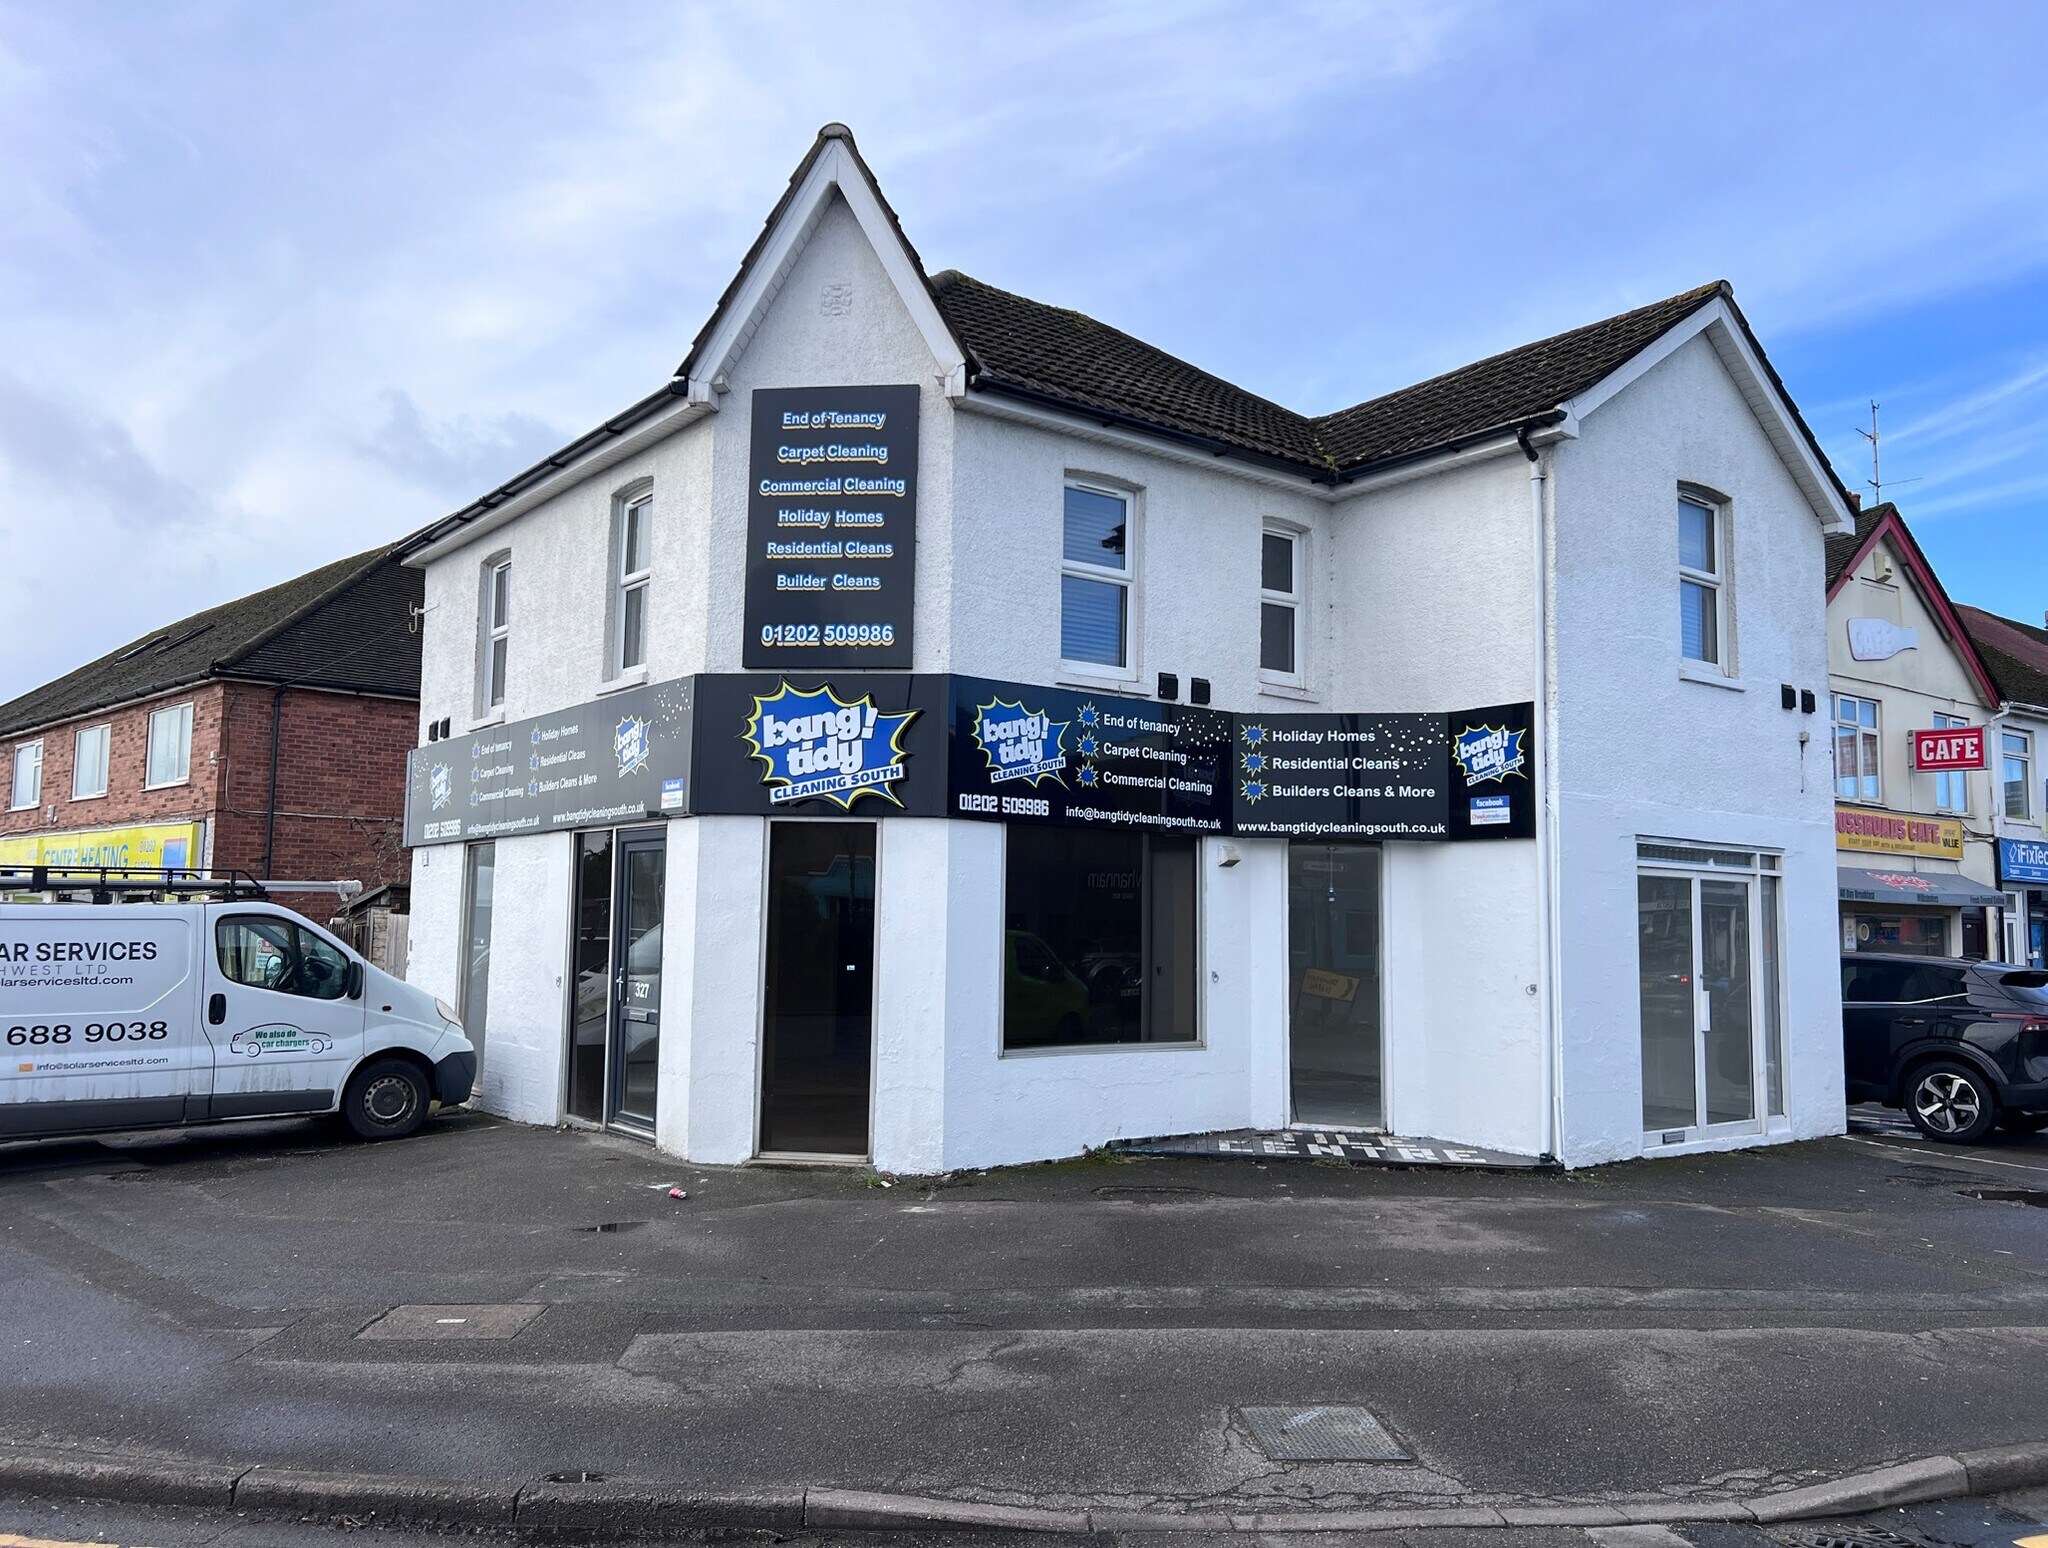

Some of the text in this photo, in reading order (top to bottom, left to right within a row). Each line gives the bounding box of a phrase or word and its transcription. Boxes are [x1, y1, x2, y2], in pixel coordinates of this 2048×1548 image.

[783, 411, 886, 429] End of Tenancy
[778, 445, 888, 464] Carpet Cleaning
[760, 477, 906, 496] Commercial Cleaning
[778, 509, 884, 528] Holiday Homes
[767, 542, 893, 558] Residential Cleans
[777, 574, 881, 590] Builder Cleans
[761, 625, 894, 646] 01202 509986
[541, 724, 579, 741] Holiday Homes
[763, 705, 878, 748] bang!
[983, 714, 1050, 744] bang!
[1103, 713, 1181, 736] End of tenancy
[1272, 730, 1376, 745] Holiday Homes
[1459, 730, 1510, 758] bang!
[540, 749, 586, 767] Residential Cleans
[786, 736, 863, 777] tidy
[998, 736, 1044, 765] tidy
[1103, 742, 1188, 766] Carpet Cleaning
[1920, 737, 1979, 761] CAFE
[1272, 757, 1400, 770] Residential Cleans
[1471, 747, 1506, 771] tidy
[495, 764, 514, 776] Cleaning
[992, 758, 1065, 782] CLEANING SOUTH
[1468, 757, 1524, 785] CLEANING SOUTH
[538, 779, 559, 793] Builders
[560, 776, 578, 789] Cleans
[583, 774, 597, 785] More
[773, 766, 901, 800] CLEANING SOUTH
[1103, 771, 1213, 796] Commercial Cleaning
[1272, 784, 1436, 798] Builders Cleans & More
[479, 786, 524, 802] Commercial Cleaning
[1476, 798, 1504, 808] facebook
[552, 800, 645, 824] www.bangtidycleaningsouth.co.uk
[959, 793, 1050, 816] 01202 509986
[1065, 805, 1221, 830] info@bangtidycleaningsouth.co.uk
[1835, 810, 1941, 844] OSSROADS CAFE
[1237, 821, 1446, 836] www.bangtidycleaningsouth.co.uk
[1942, 838, 1959, 848] VALUE
[80, 844, 129, 869] HEATING
[0, 941, 157, 962] AR SERVICES
[75, 964, 108, 975] LTD
[1, 975, 133, 987] larservicesltd.com
[635, 982, 650, 999] 327
[6, 1021, 168, 1046] 688 9038
[255, 1029, 297, 1039] We also do
[276, 1038, 310, 1048] chargers
[36, 1057, 169, 1071] info@solarservicesltd.com
[1219, 1139, 1487, 1164] CENTRE
